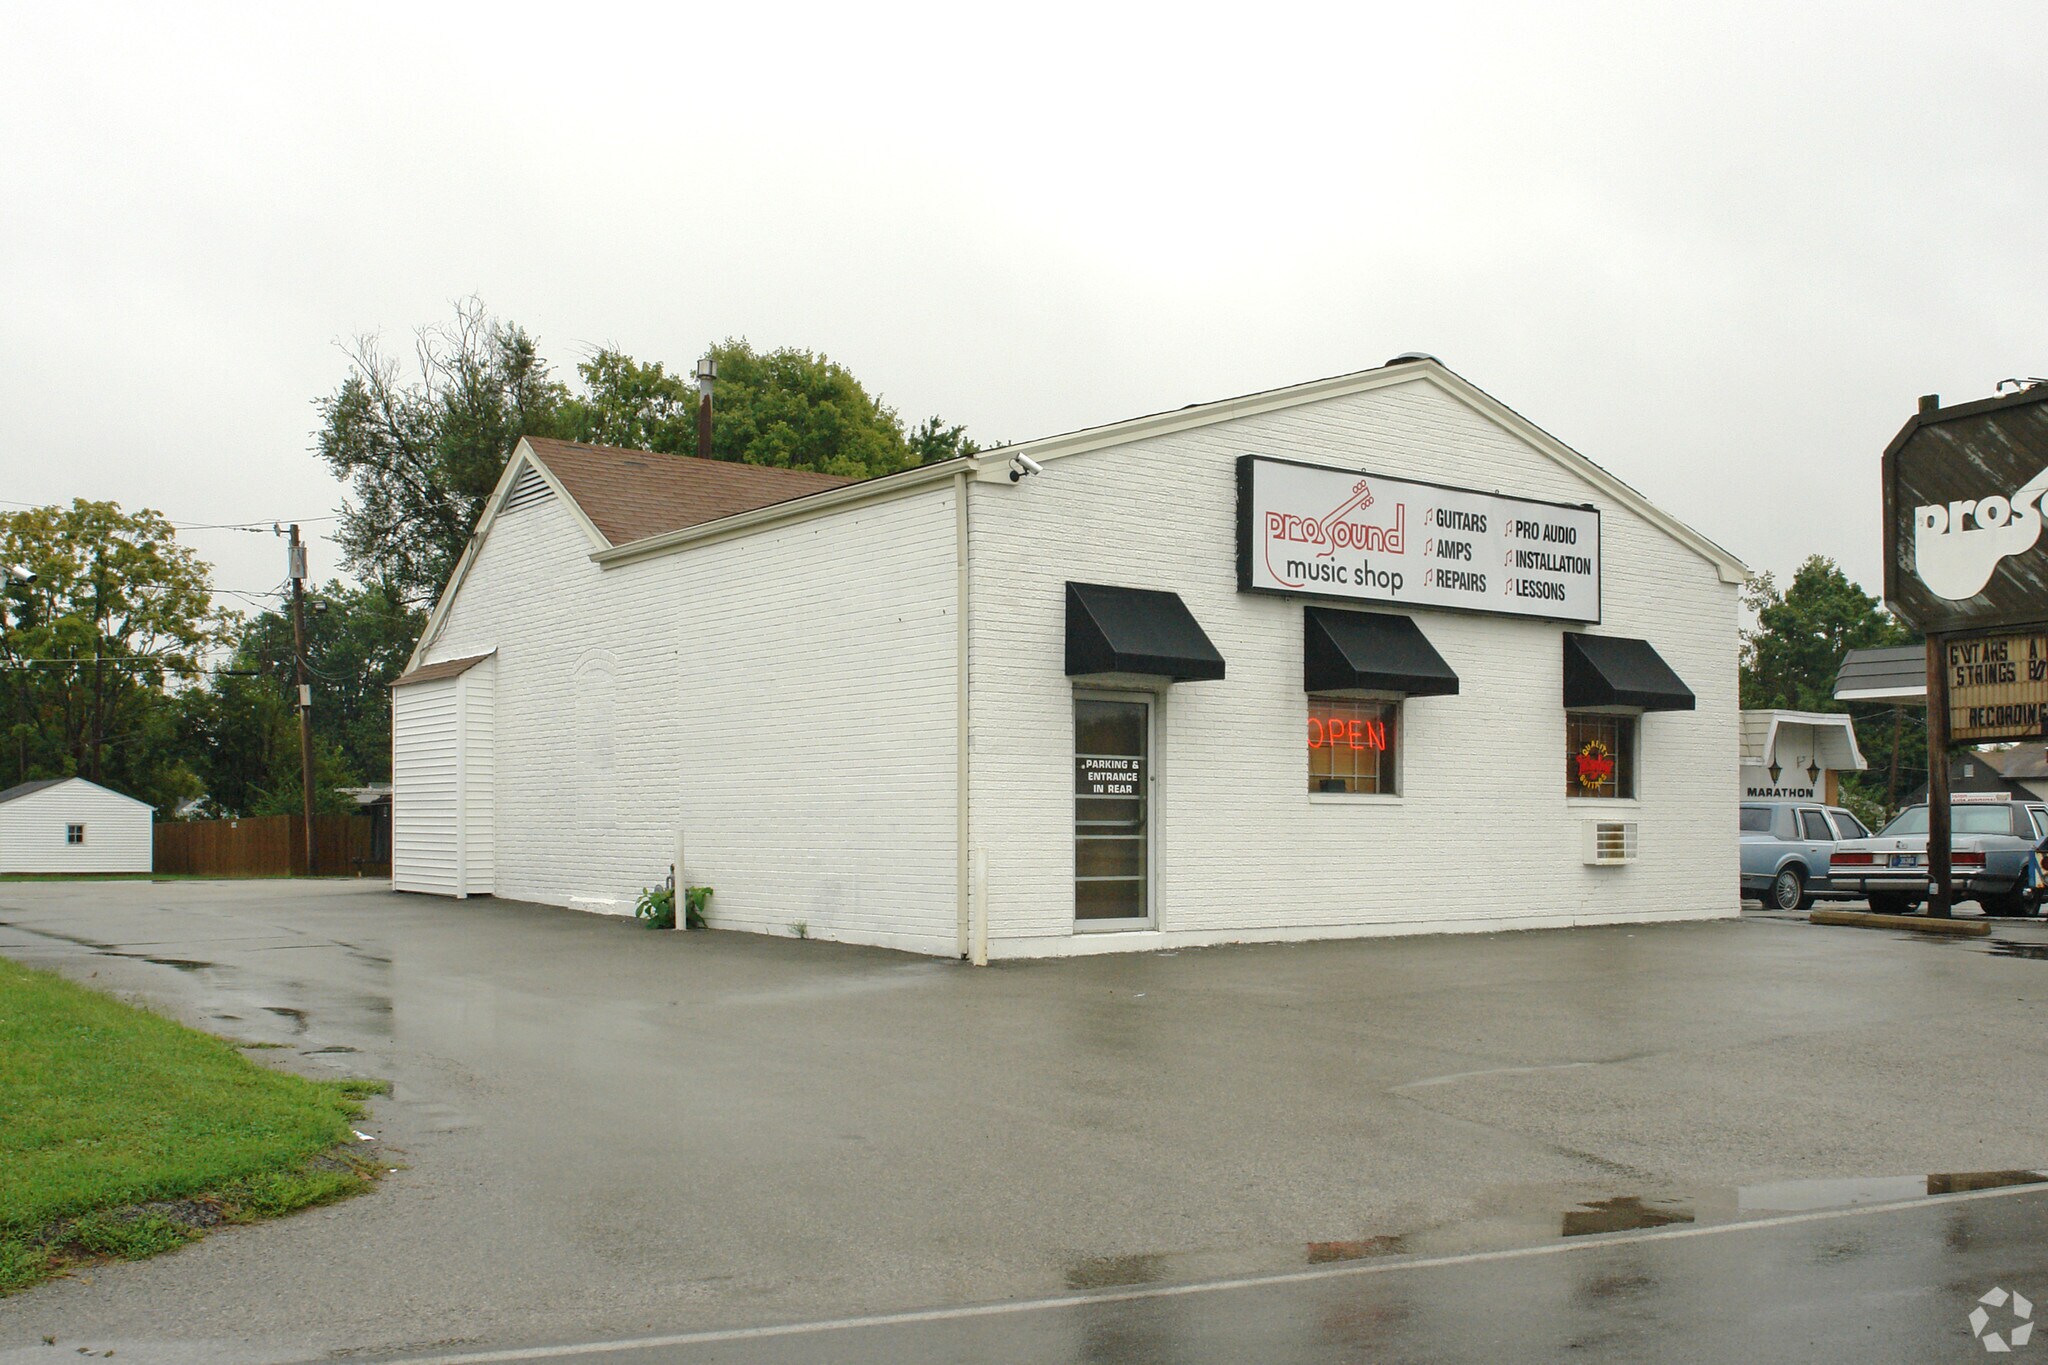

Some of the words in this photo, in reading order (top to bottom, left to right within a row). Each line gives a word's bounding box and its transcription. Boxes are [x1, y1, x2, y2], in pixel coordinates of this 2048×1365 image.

[1436, 508, 1488, 533] GUITARS
[1515, 520, 1540, 541] PRO
[1542, 524, 1577, 545] AUDIO
[1436, 539, 1472, 561] AMPS
[1515, 550, 1592, 575] INSTALLATION
[1286, 556, 1348, 584] music
[1354, 559, 1404, 596] shop
[1436, 569, 1487, 593] REPAIRS
[1515, 579, 1566, 601] LESSONS
[1956, 661, 2016, 687] STRINGS
[1307, 717, 1386, 751] OPEN
[1581, 739, 1608, 757] QUALITY
[1085, 759, 1128, 769] PARKING
[1132, 760, 1139, 769] &
[1087, 771, 1138, 782] ENTRANCE
[1093, 784, 1104, 793] IN
[1107, 784, 1133, 794] REAR
[1746, 787, 1814, 798] MARATHON
